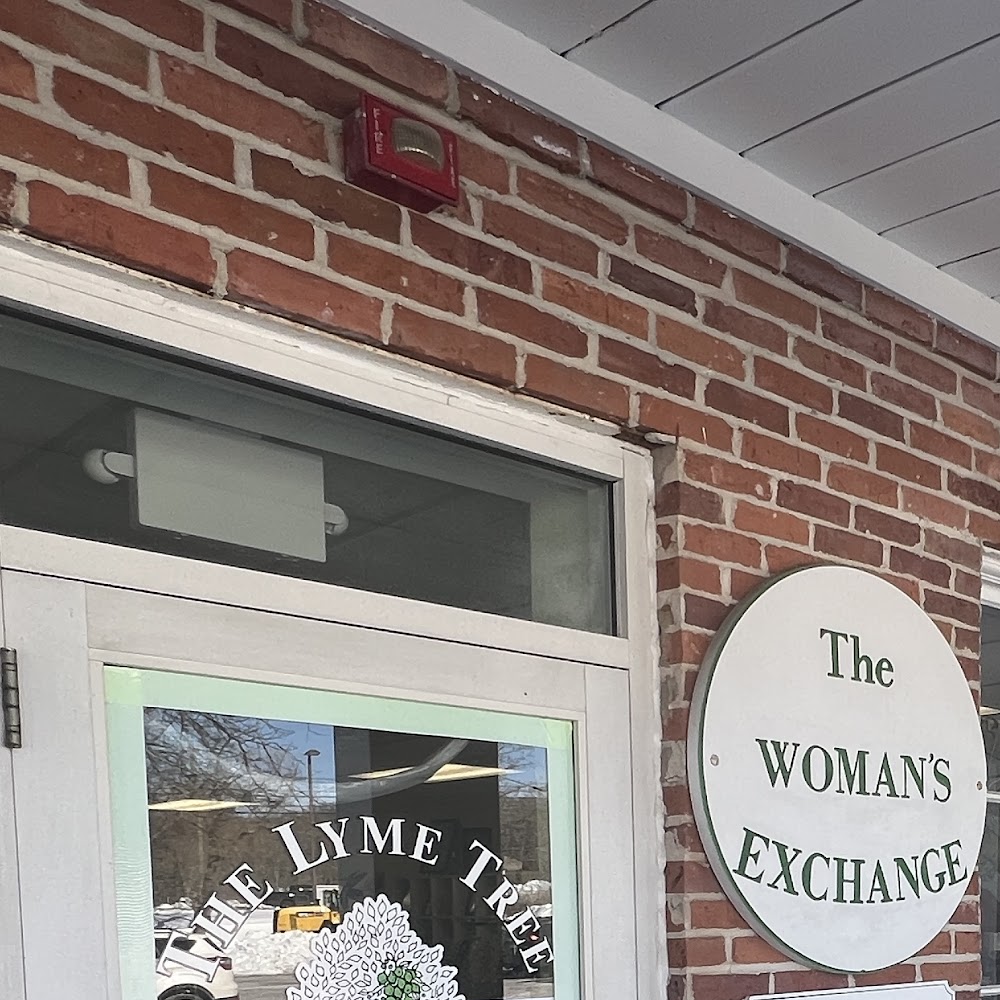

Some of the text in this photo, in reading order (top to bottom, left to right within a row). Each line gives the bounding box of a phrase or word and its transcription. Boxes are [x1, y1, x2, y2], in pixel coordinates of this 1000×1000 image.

[372, 107, 384, 155] FIRE
[819, 627, 895, 688] The
[755, 738, 952, 803] WOMAN'S
[732, 826, 968, 905] EXCHANGE
[156, 815, 555, 983] THE LYME TREE
